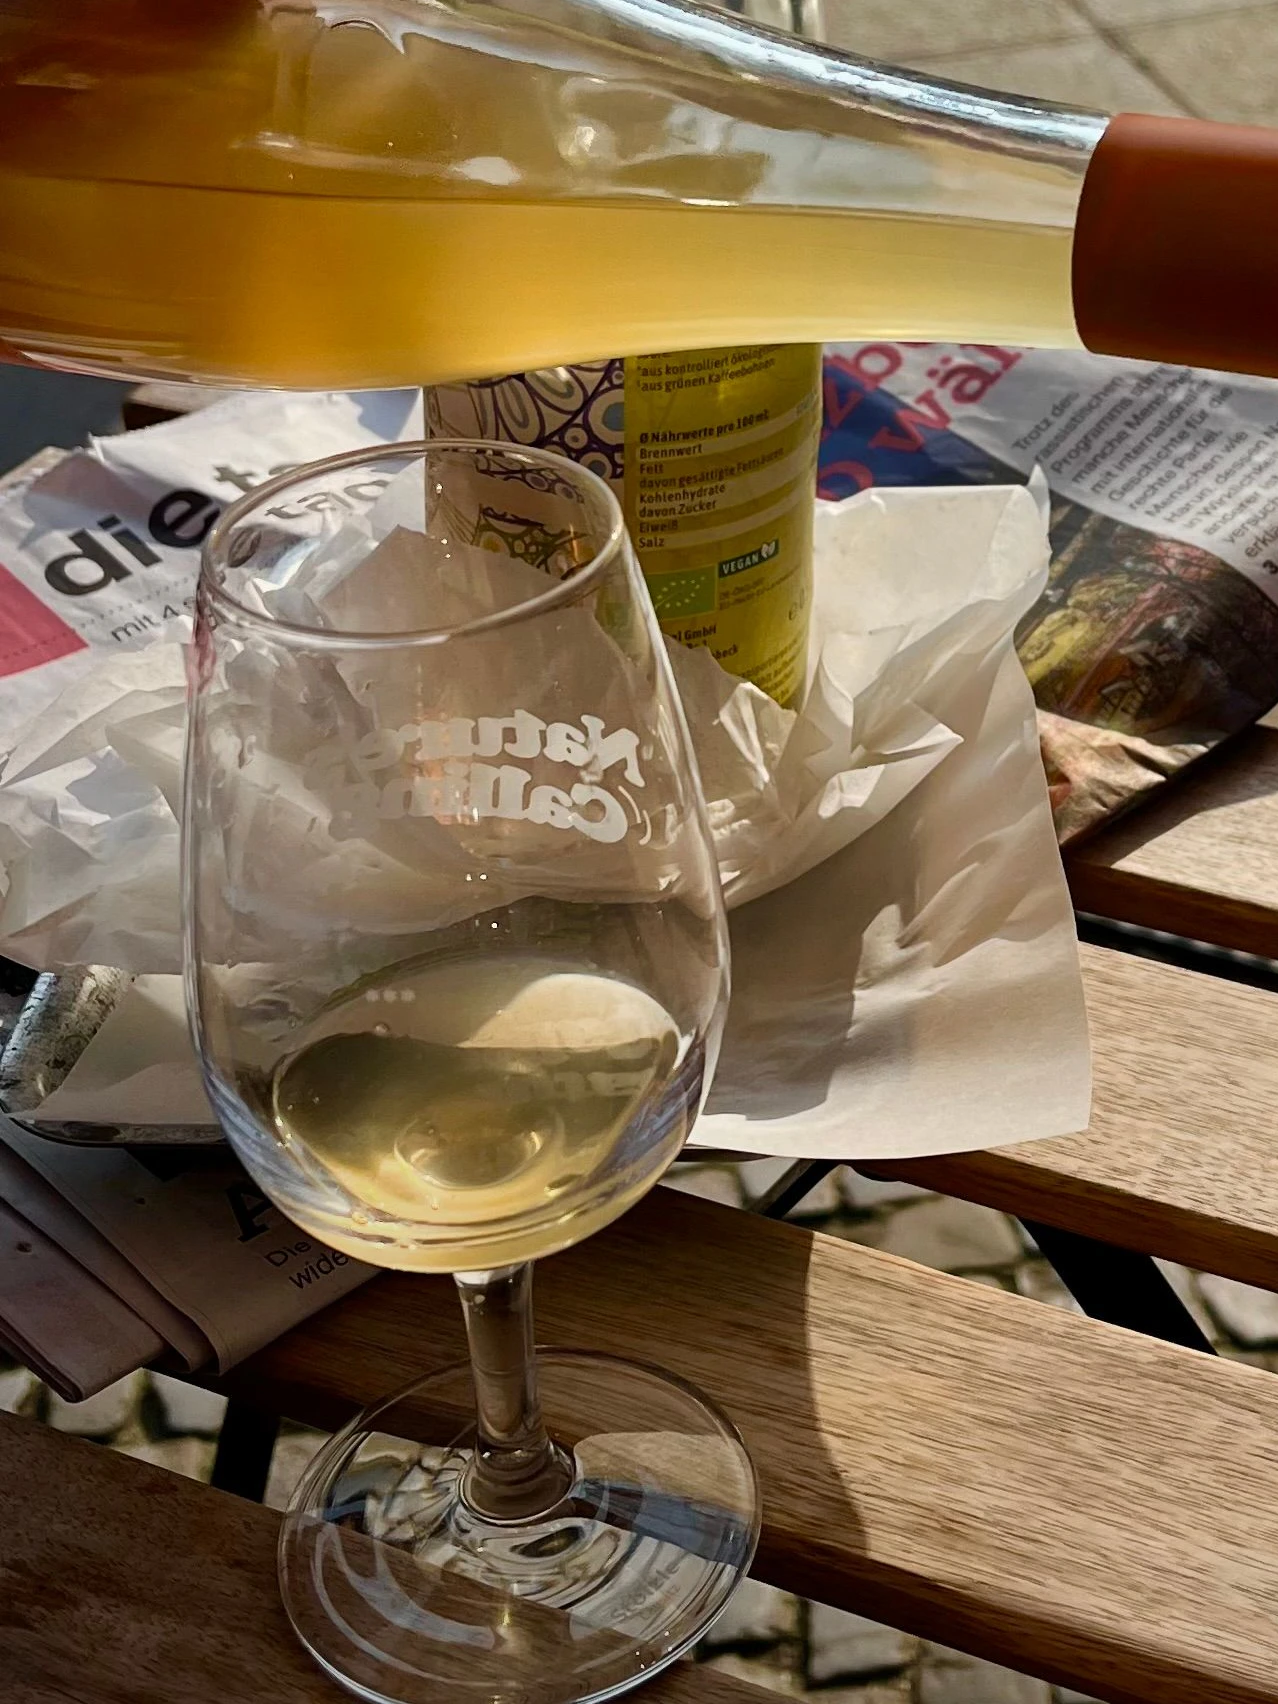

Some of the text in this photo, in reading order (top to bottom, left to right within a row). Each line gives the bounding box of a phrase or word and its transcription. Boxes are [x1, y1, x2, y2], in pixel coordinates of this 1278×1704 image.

[665, 356, 729, 375] kontrolliert
[665, 374, 706, 393] grünen
[651, 426, 714, 443] Nährwerte
[716, 423, 734, 437] pro
[736, 414, 754, 430] 100
[1012, 391, 1080, 450] Trotz des
[1034, 376, 1125, 464] rassistischen
[1051, 396, 1133, 474] Programms
[1108, 387, 1233, 501] Geschichte für die
[640, 444, 703, 460] Brennwert
[1072, 429, 1130, 484] manche
[1215, 439, 1269, 485] dessen
[640, 463, 664, 475] Fett
[640, 474, 676, 488] davon
[679, 465, 735, 487] gesättigte
[1091, 469, 1118, 494] mit
[1145, 431, 1249, 517] Menschen wie
[640, 484, 726, 504] Kohlenhydrate
[1129, 470, 1177, 510] rechte
[639, 500, 717, 518] davon Zucker
[1203, 490, 1260, 536] anderer
[639, 520, 678, 533] Eiweiß
[45, 489, 222, 597] die
[639, 537, 665, 549] Salz
[722, 551, 760, 575] VEGAN
[111, 614, 162, 642] mit
[684, 624, 717, 641] GmbH
[264, 1240, 312, 1268] Die
[288, 1249, 350, 1290] wide
